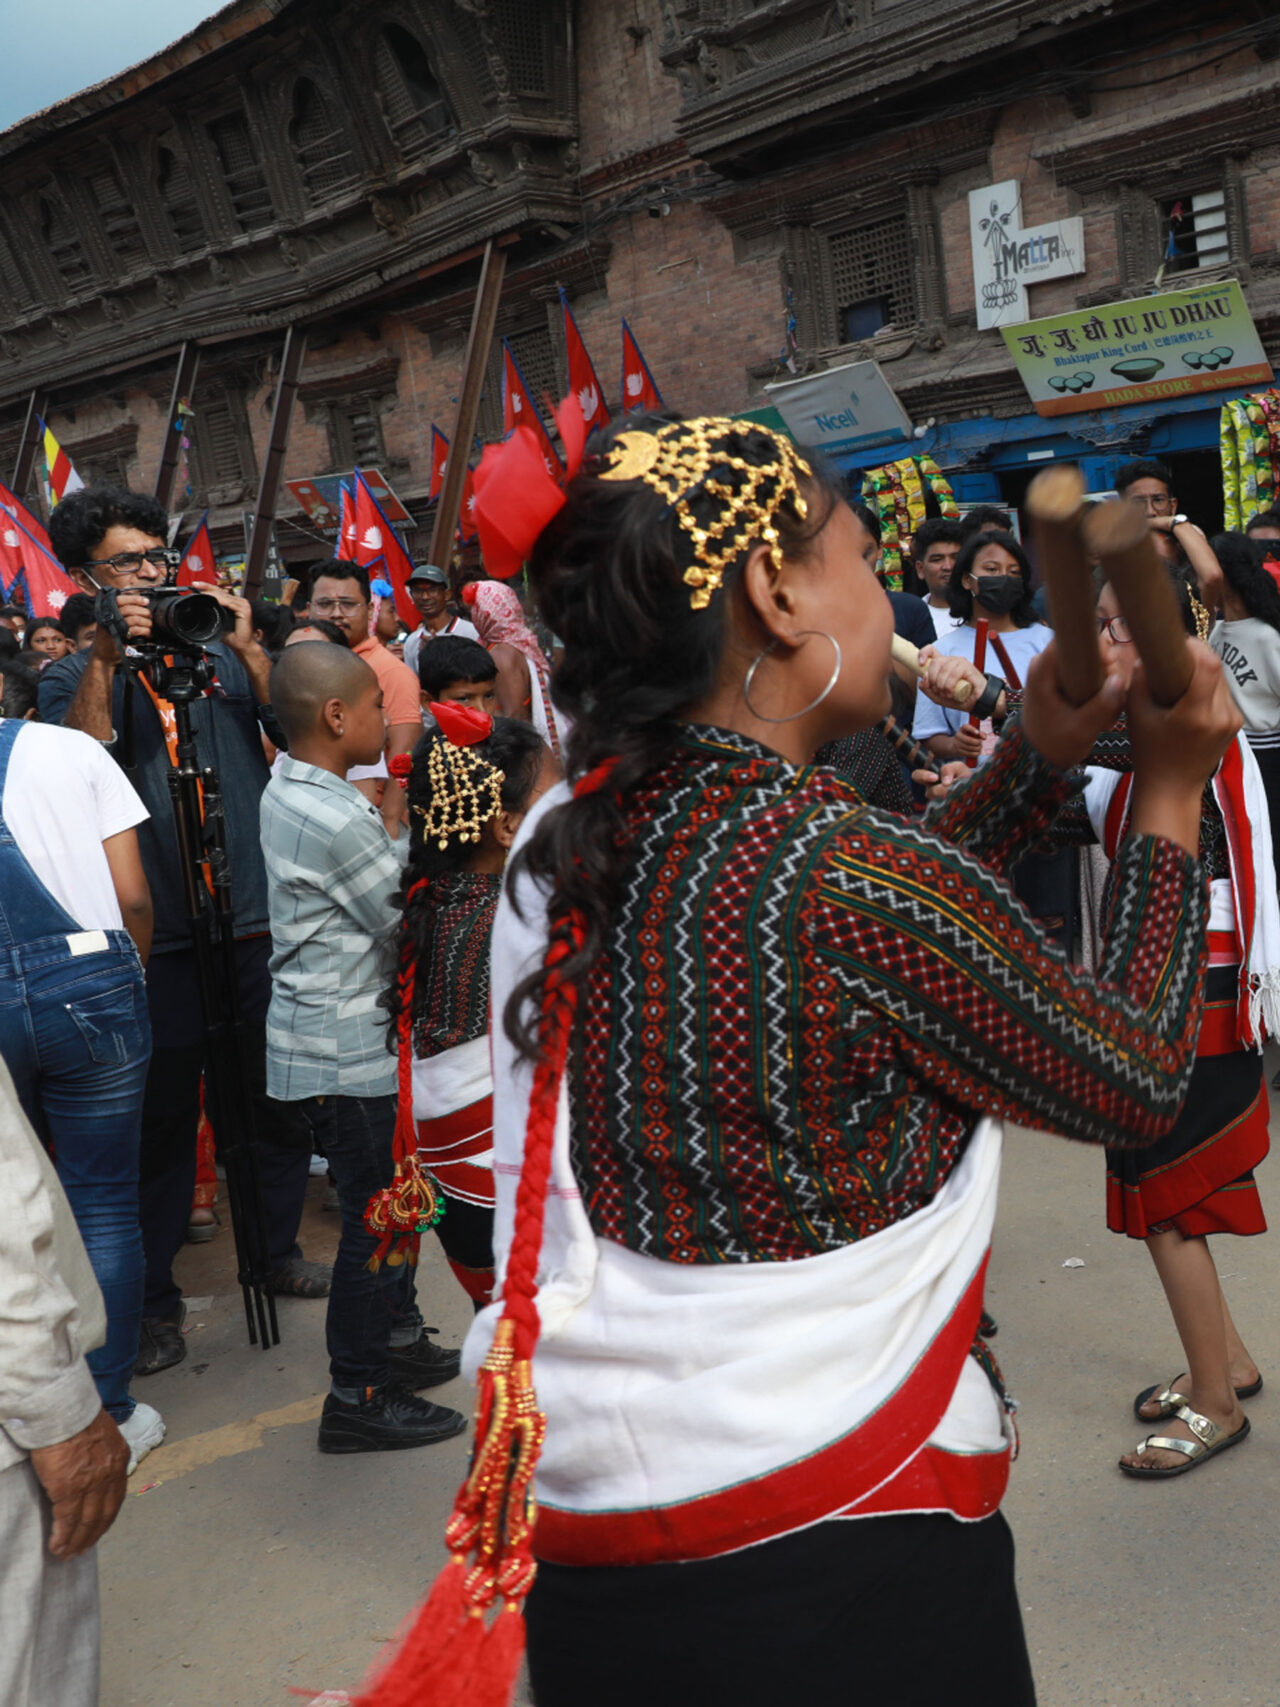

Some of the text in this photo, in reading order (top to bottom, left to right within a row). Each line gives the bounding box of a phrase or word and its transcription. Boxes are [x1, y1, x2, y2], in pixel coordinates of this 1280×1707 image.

[1112, 296, 1233, 339] JU JU DHAU
[1053, 341, 1148, 367] Bhaktapur King Curd
[1103, 387, 1144, 404] HADA
[1144, 379, 1193, 397] STORE
[814, 407, 858, 432] Ncell
[1221, 641, 1258, 688] YORK
